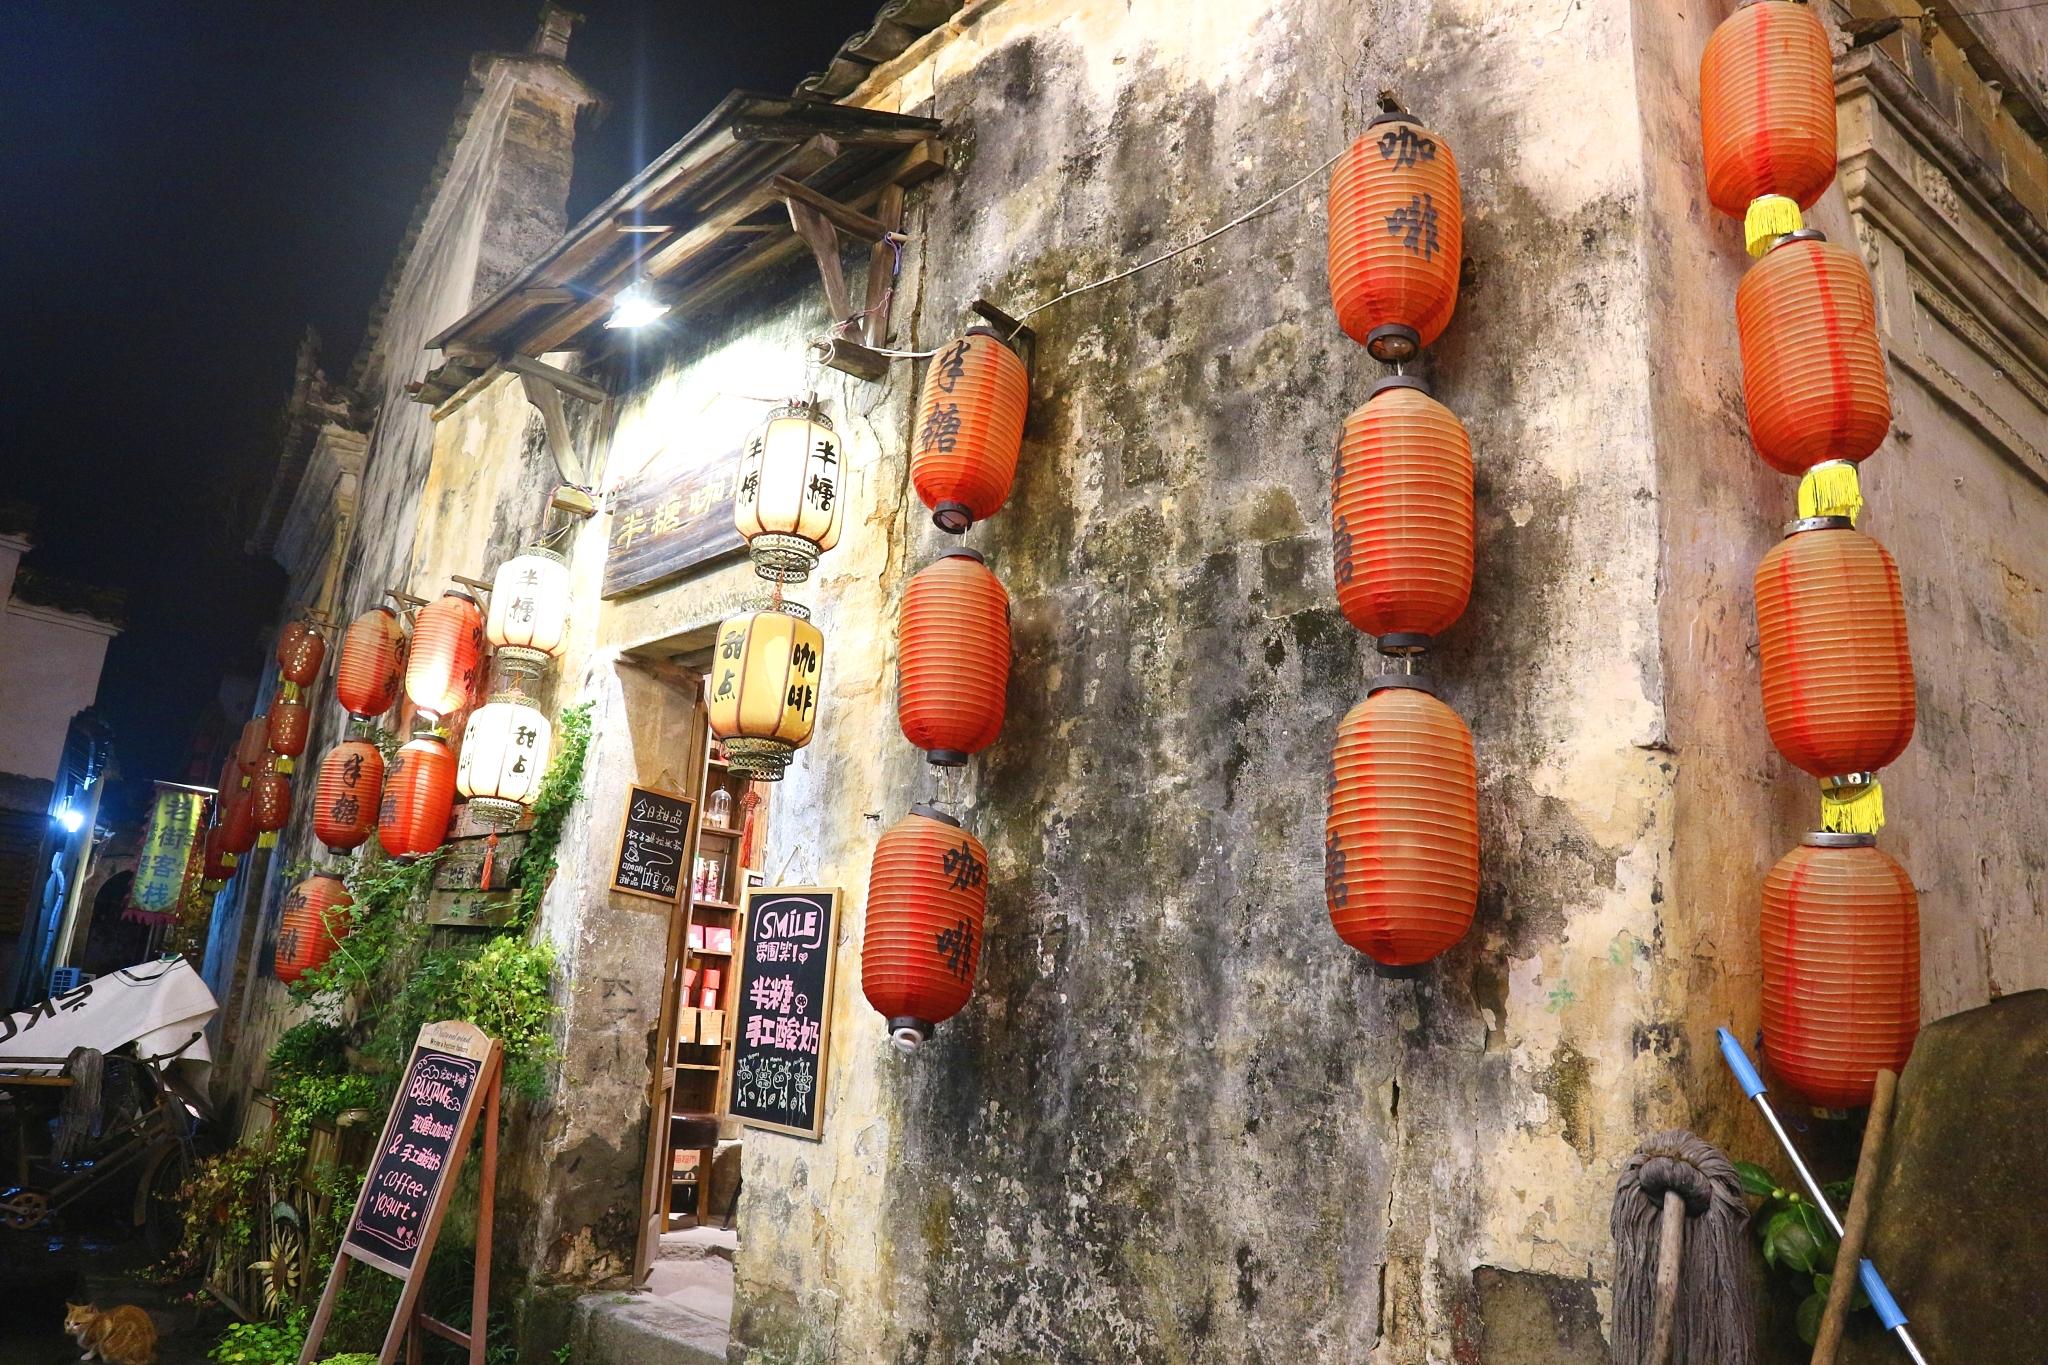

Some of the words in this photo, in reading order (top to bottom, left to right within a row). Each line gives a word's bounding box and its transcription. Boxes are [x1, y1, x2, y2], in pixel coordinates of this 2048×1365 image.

[1377, 125, 1440, 263] 咖啡
[920, 339, 971, 454] 半糖
[739, 435, 763, 507] 半糖
[807, 440, 837, 512] 半糖
[616, 480, 736, 550] 半糖咖
[509, 569, 538, 623] 半糖
[714, 629, 745, 703] 甜点
[787, 641, 817, 722] 咖啡
[508, 725, 537, 780] 甜点
[331, 753, 365, 825] 半糖
[633, 798, 683, 825] 今日甜品
[143, 800, 192, 905] 老街客栈
[622, 862, 643, 875] 咖啡
[279, 886, 307, 965] 咖啡
[935, 841, 983, 984] 咖啡
[749, 974, 795, 1014] 半糖
[745, 1013, 819, 1055] 手工酸奶
[410, 1076, 453, 1107] BANTANG
[388, 1133, 404, 1155] &
[399, 1143, 441, 1171] 手工酸奶
[410, 1113, 454, 1142] 现磨咖啡
[372, 1191, 411, 1221] Yogurt
